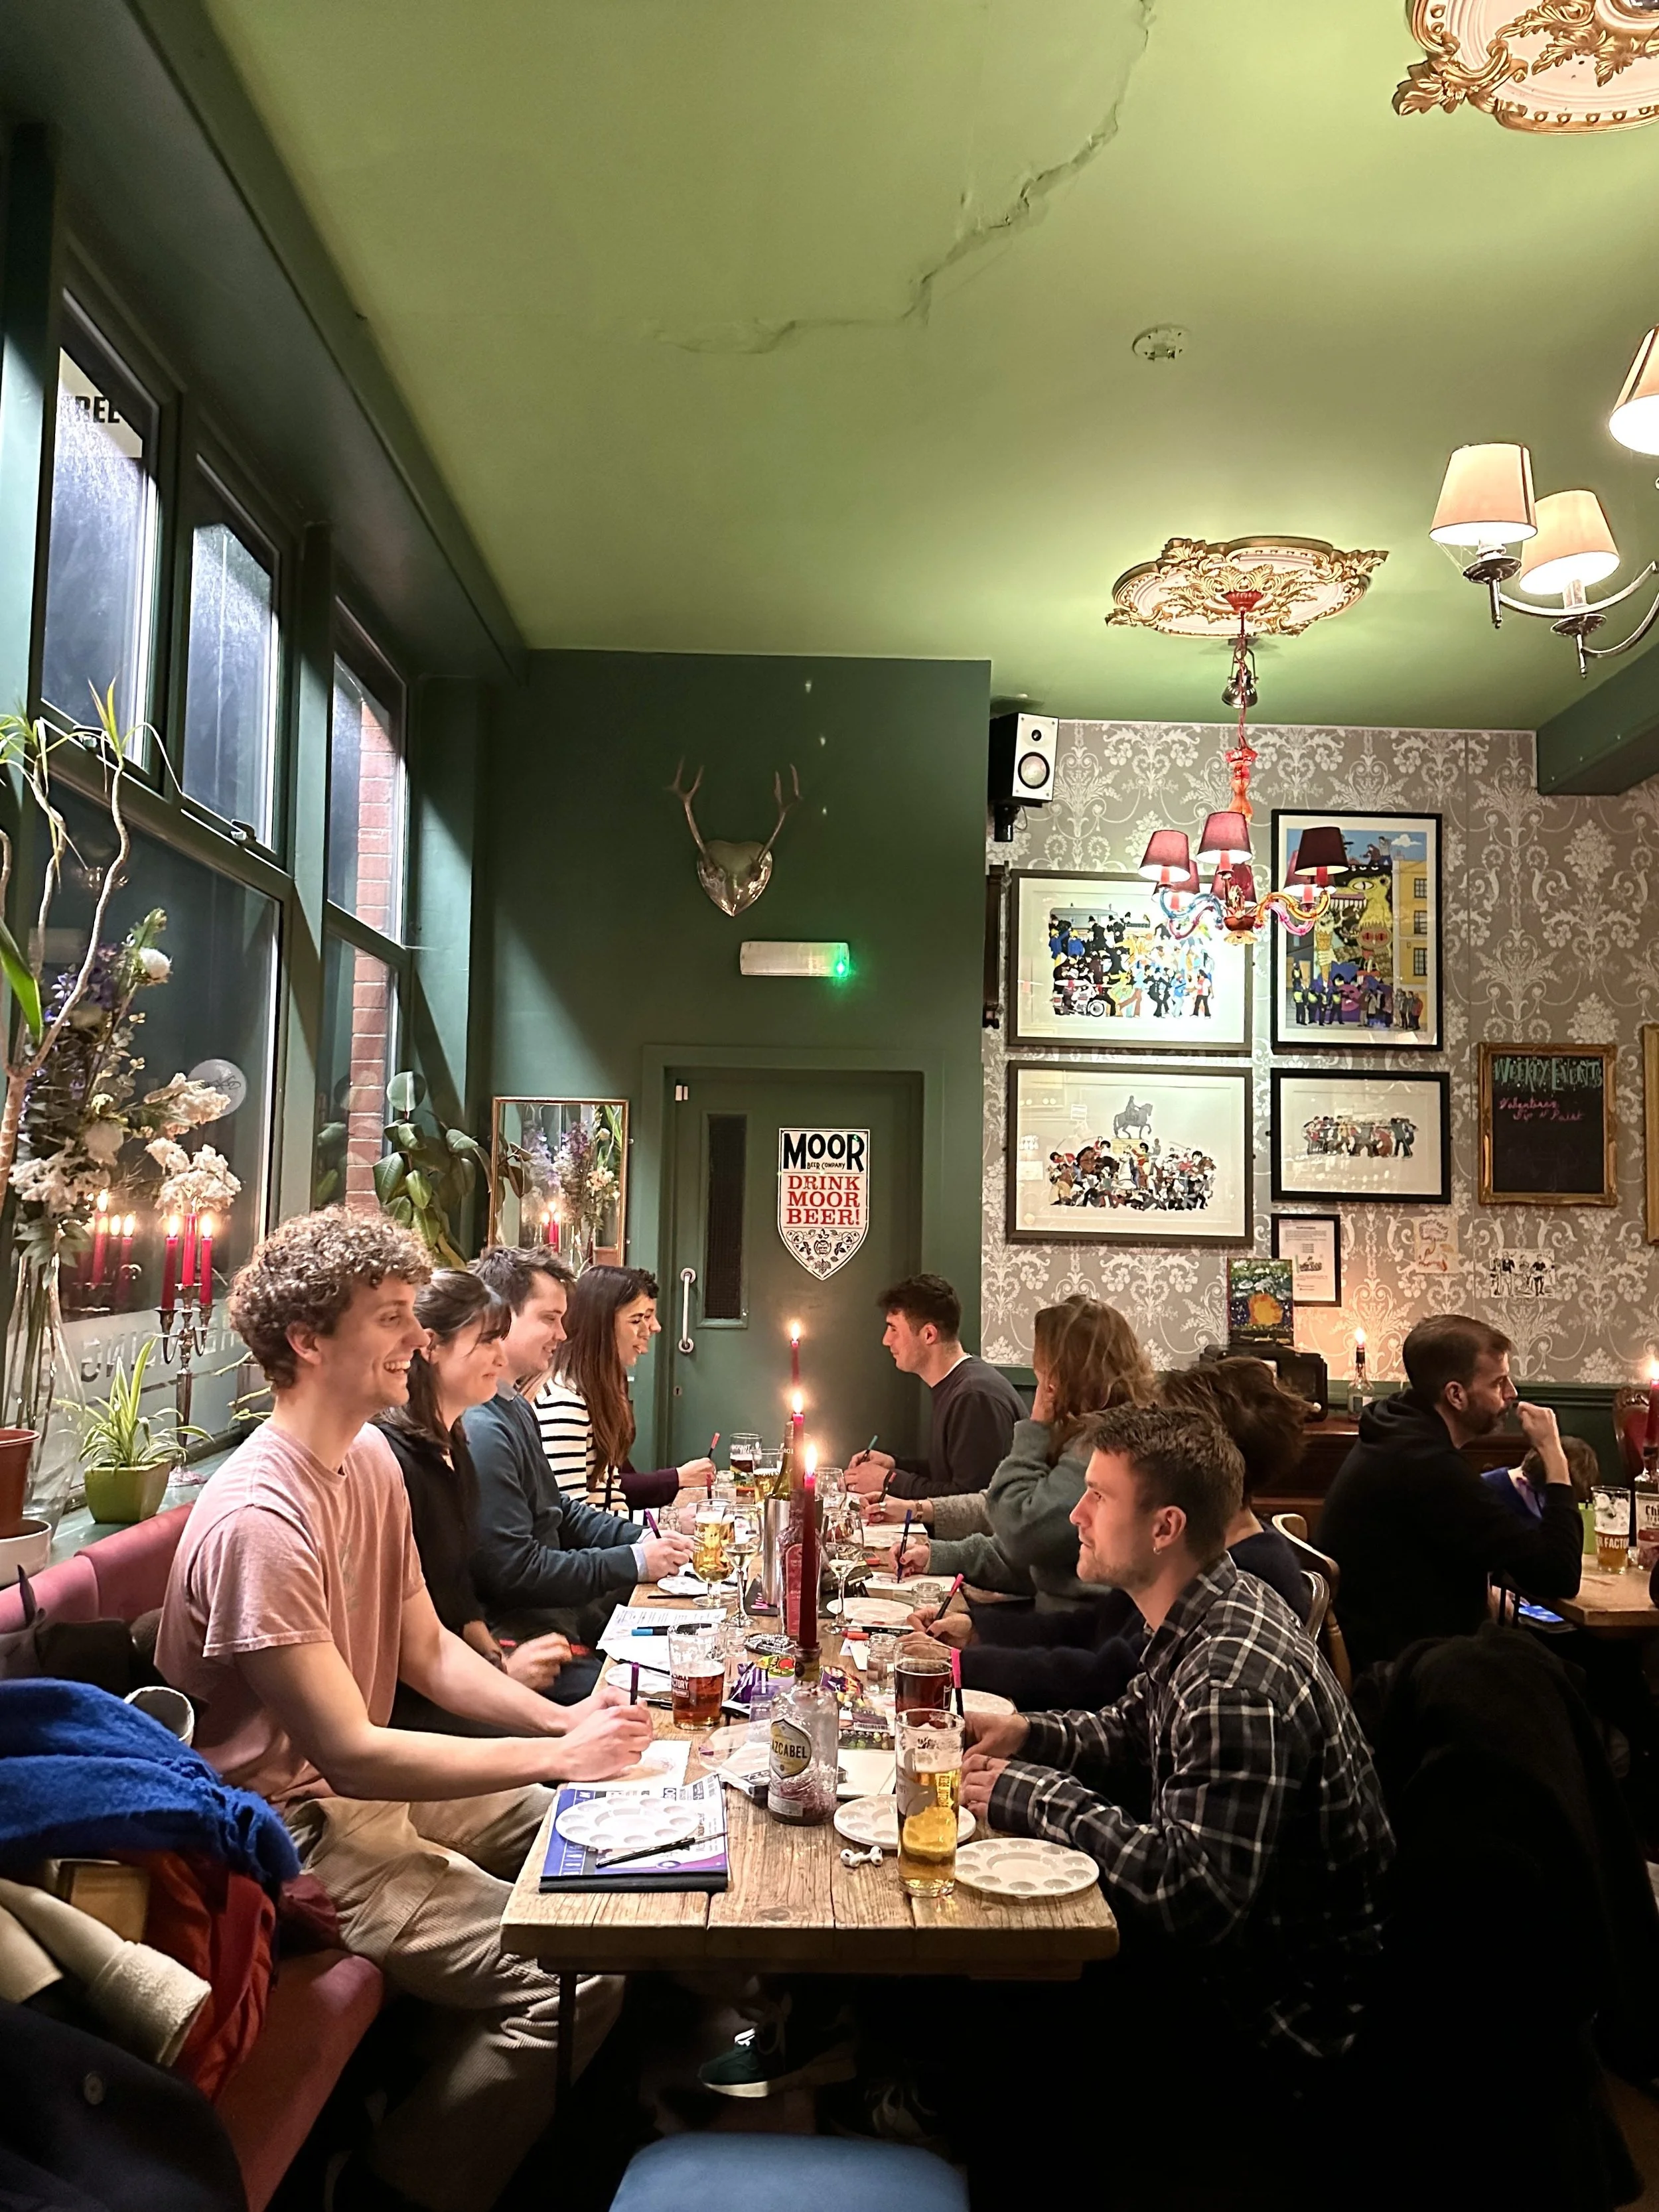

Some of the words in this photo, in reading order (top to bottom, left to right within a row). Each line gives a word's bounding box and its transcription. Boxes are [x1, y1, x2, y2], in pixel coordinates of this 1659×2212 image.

[783, 1133, 865, 1172] MOOR
[788, 1176, 860, 1190] DRINK
[788, 1192, 860, 1207] MOOR
[786, 1209, 860, 1225] BEER!
[1604, 1537, 1629, 1549] FACTO
[771, 1739, 808, 1759] AZCABEL
